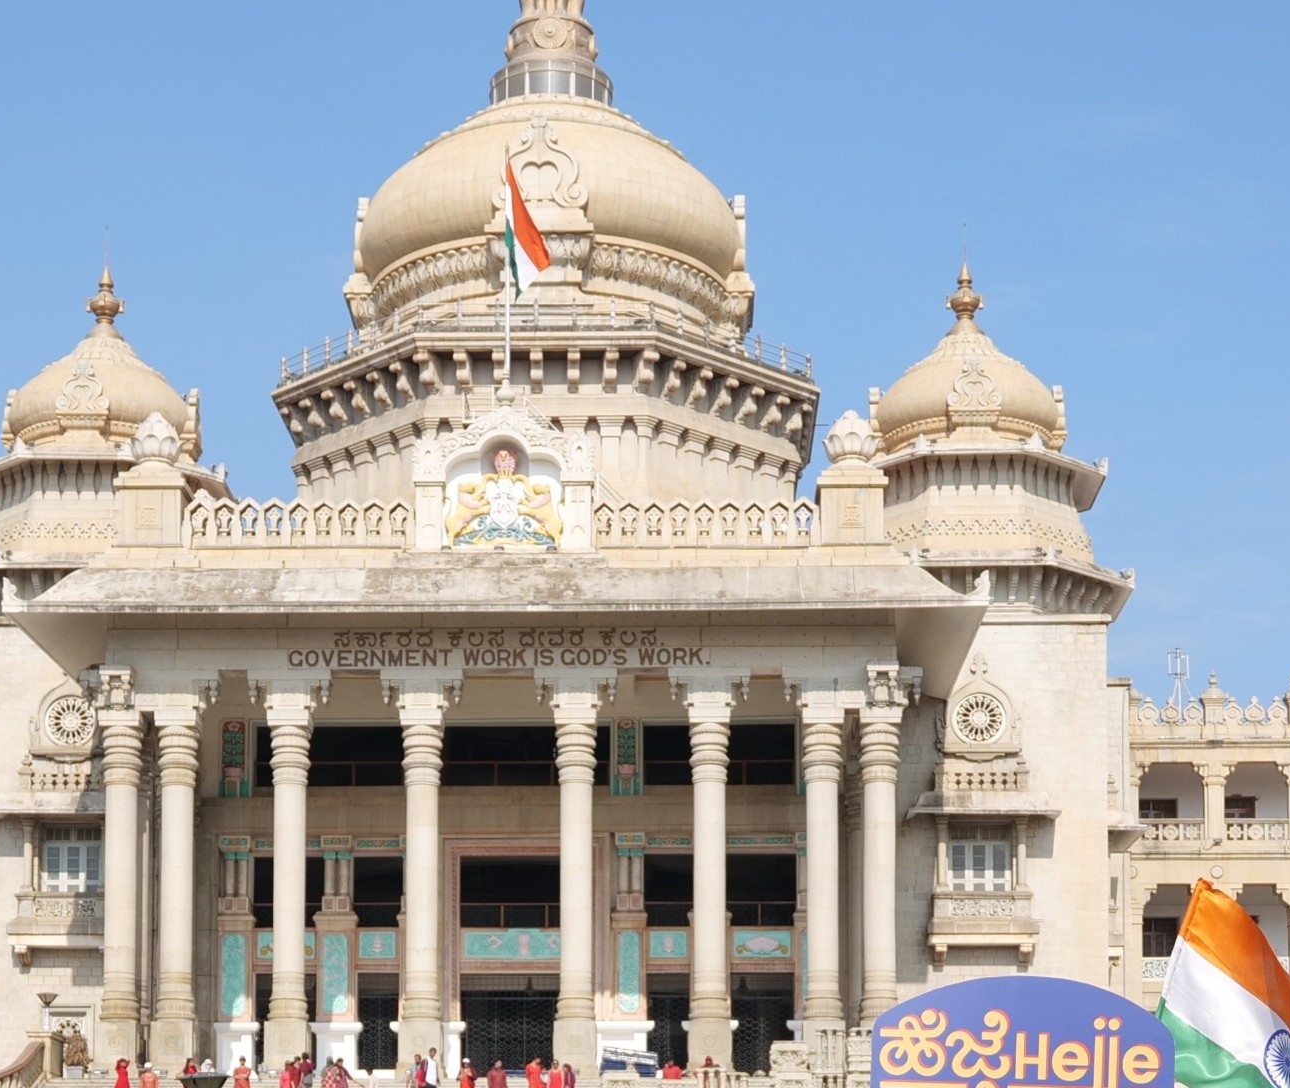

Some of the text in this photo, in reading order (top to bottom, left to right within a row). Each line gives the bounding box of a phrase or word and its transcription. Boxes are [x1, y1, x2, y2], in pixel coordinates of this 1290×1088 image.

[447, 628, 505, 647] ಕೆಲಸ
[519, 627, 584, 647] ದೇವರ
[288, 647, 710, 667] GOVERNMENT WORK IS GOD'S WORK.
